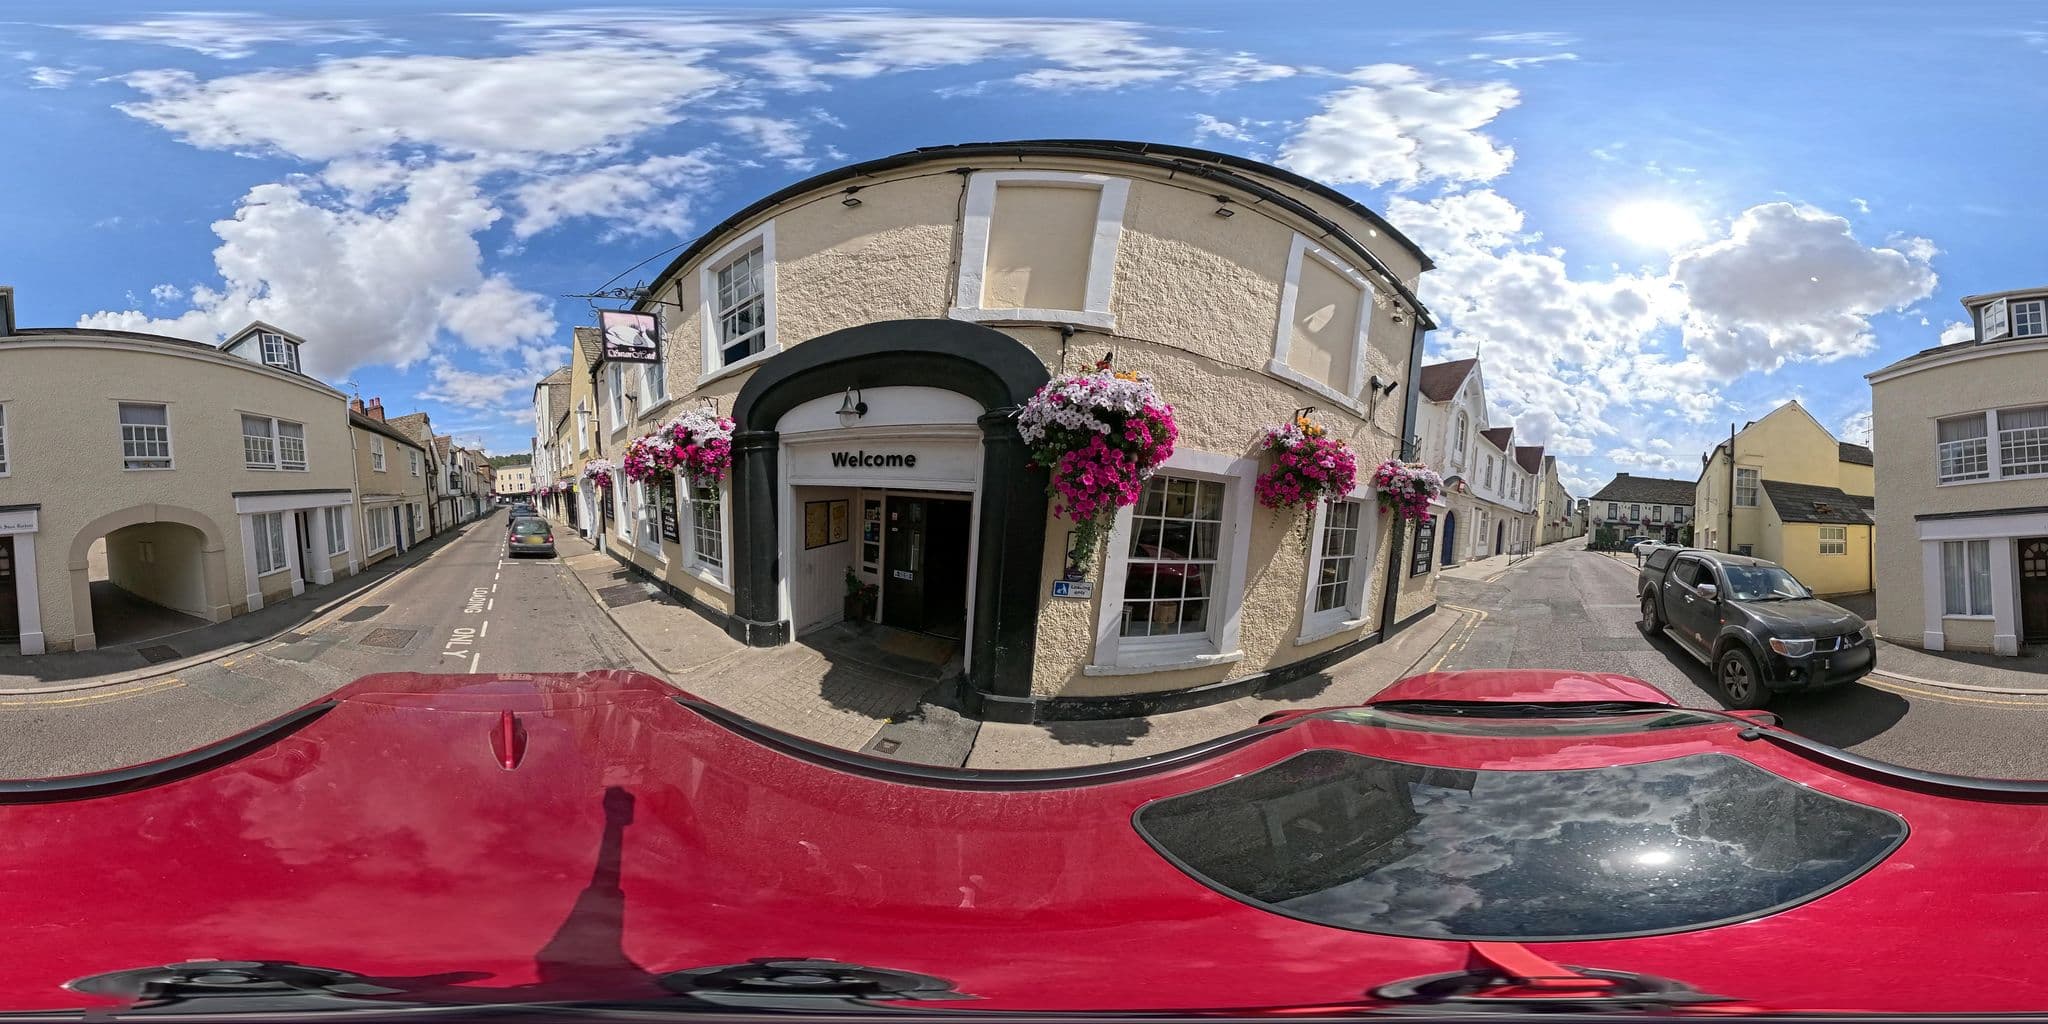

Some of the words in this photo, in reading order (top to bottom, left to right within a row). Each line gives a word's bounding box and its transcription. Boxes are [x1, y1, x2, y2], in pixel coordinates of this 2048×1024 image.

[831, 450, 916, 468] Welcome
[464, 587, 489, 613] LOADING
[442, 627, 476, 659] ONLY
